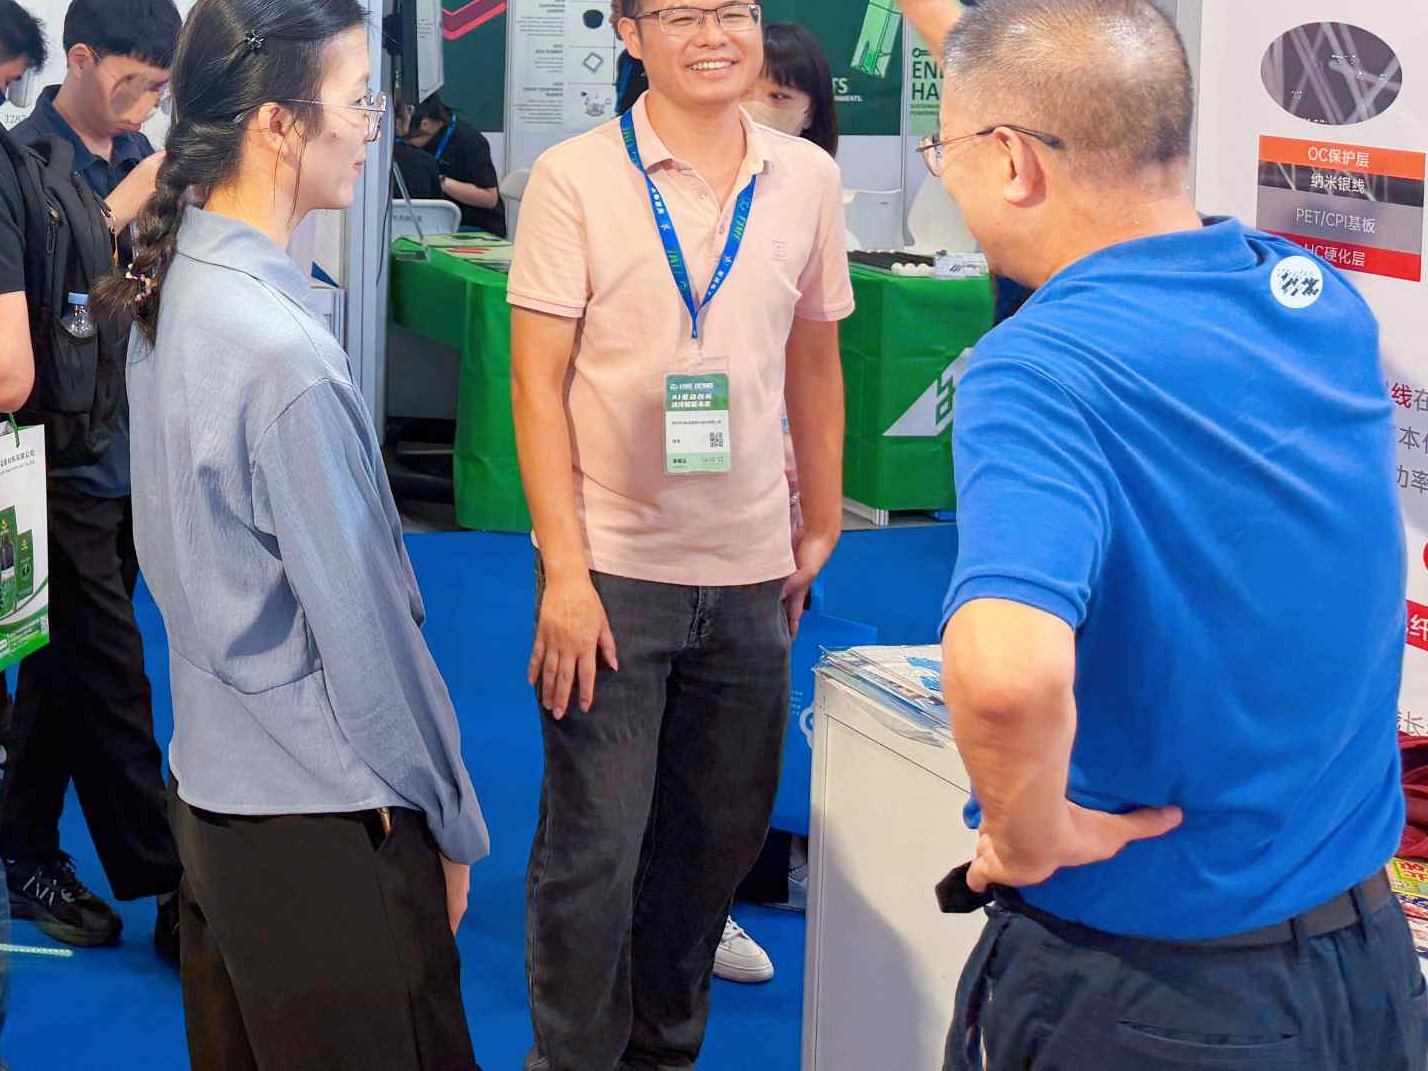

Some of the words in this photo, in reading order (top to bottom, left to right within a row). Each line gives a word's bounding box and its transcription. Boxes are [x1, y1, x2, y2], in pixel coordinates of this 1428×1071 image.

[1307, 145, 1370, 168] OC保护层
[1310, 173, 1365, 194] 纳米银线
[1296, 208, 1376, 234] PET/CPI基板
